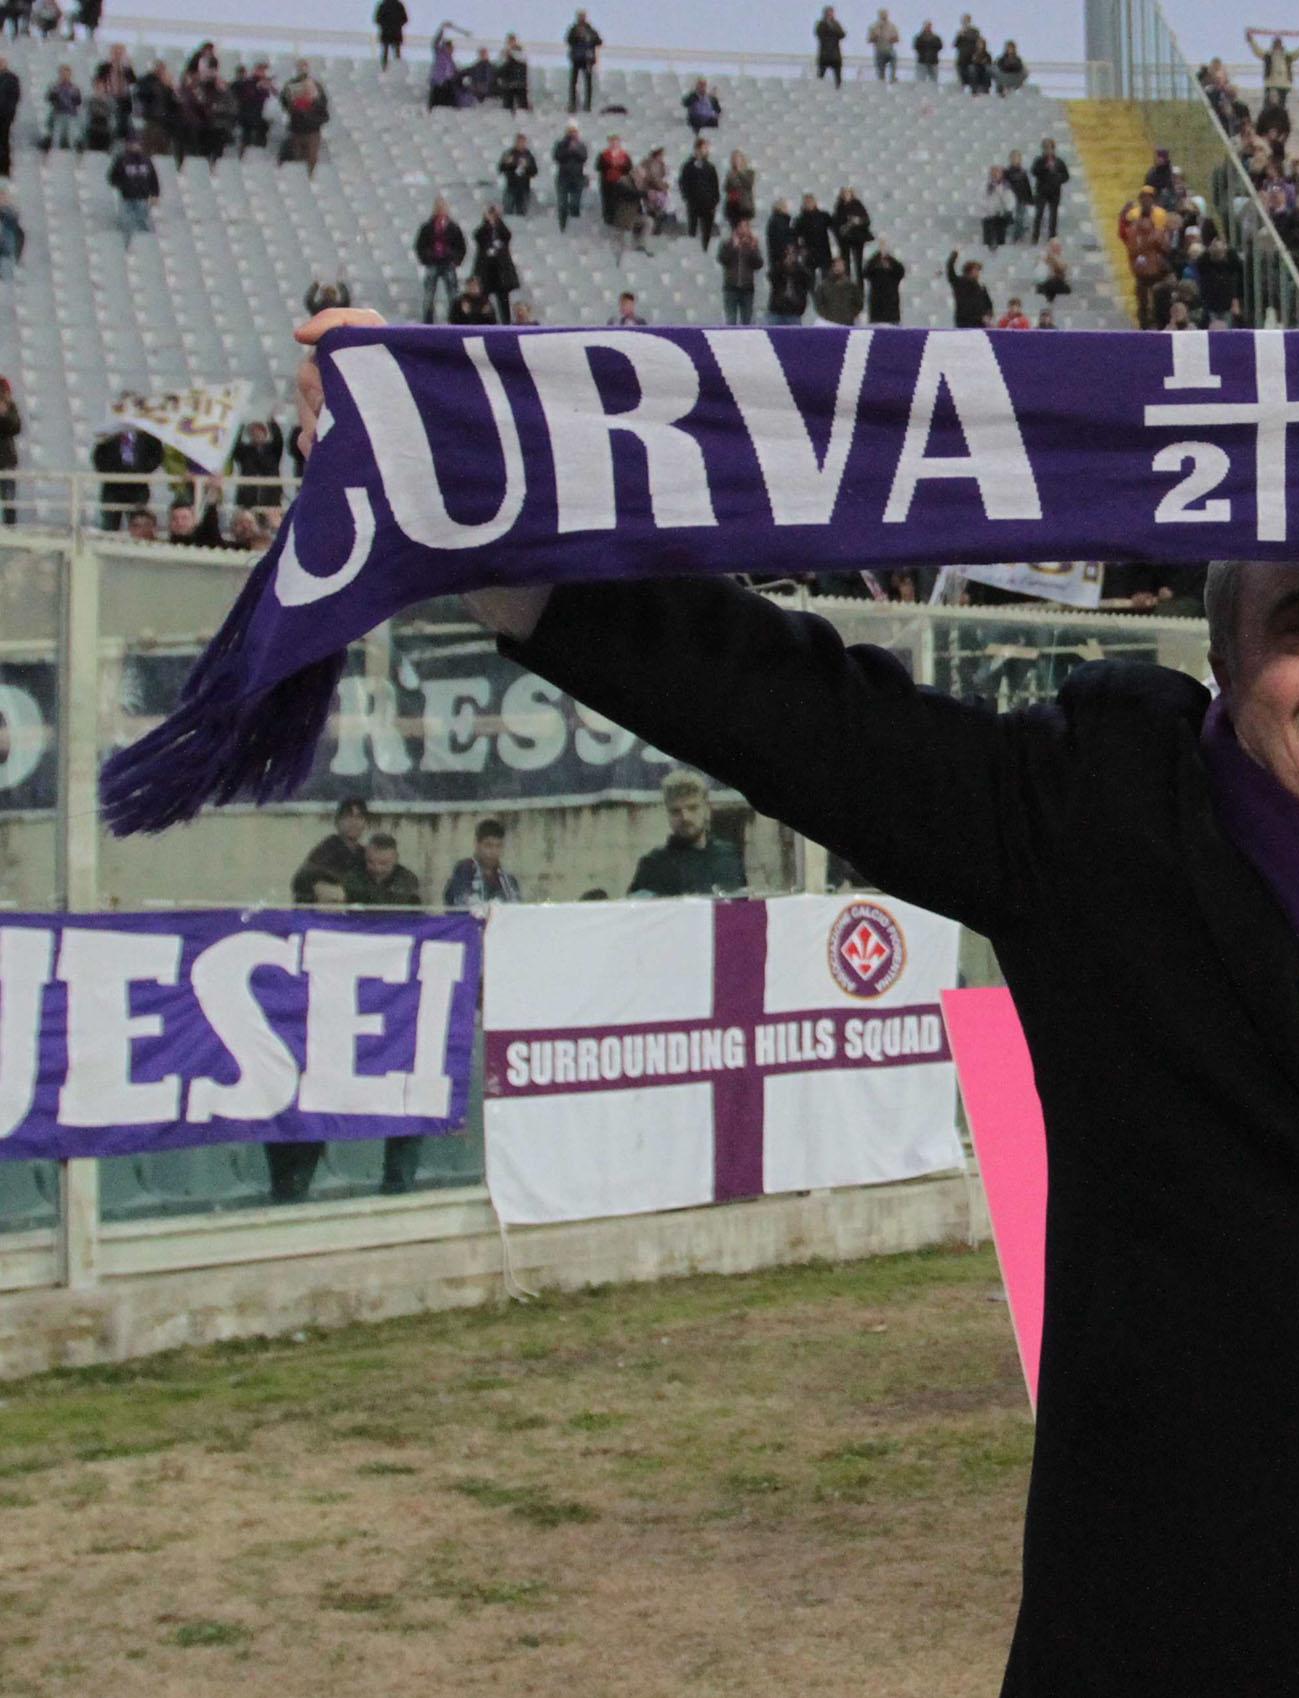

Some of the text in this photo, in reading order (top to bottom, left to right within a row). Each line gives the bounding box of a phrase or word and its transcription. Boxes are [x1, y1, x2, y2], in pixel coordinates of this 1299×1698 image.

[506, 1014, 941, 1086] SURROUNDING HILLS SQUAD
